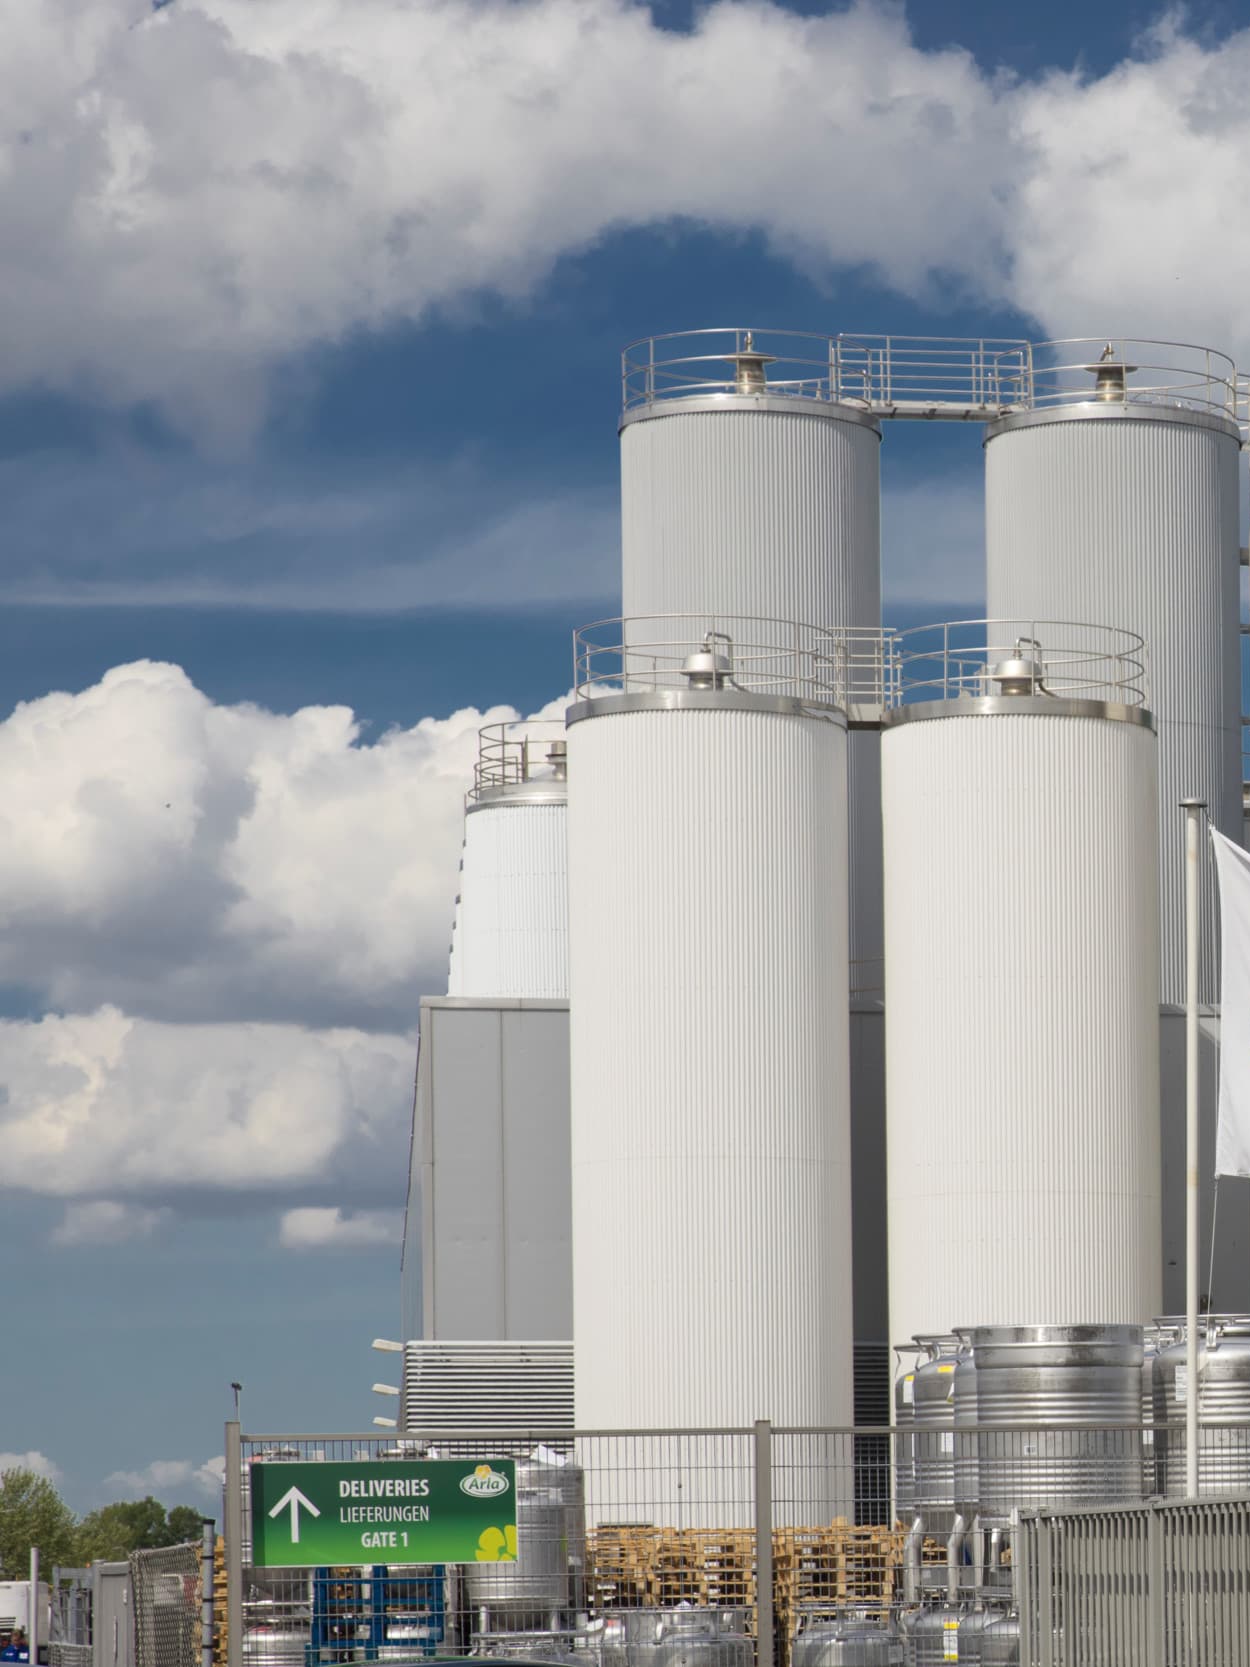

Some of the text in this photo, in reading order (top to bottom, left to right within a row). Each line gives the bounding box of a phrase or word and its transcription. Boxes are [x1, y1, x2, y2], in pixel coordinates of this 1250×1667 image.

[339, 1479, 430, 1498] DELIVERIES
[468, 1478, 500, 1490] Arla
[340, 1506, 430, 1523] LIEFERUNGEN
[361, 1532, 409, 1548] GATE 1
